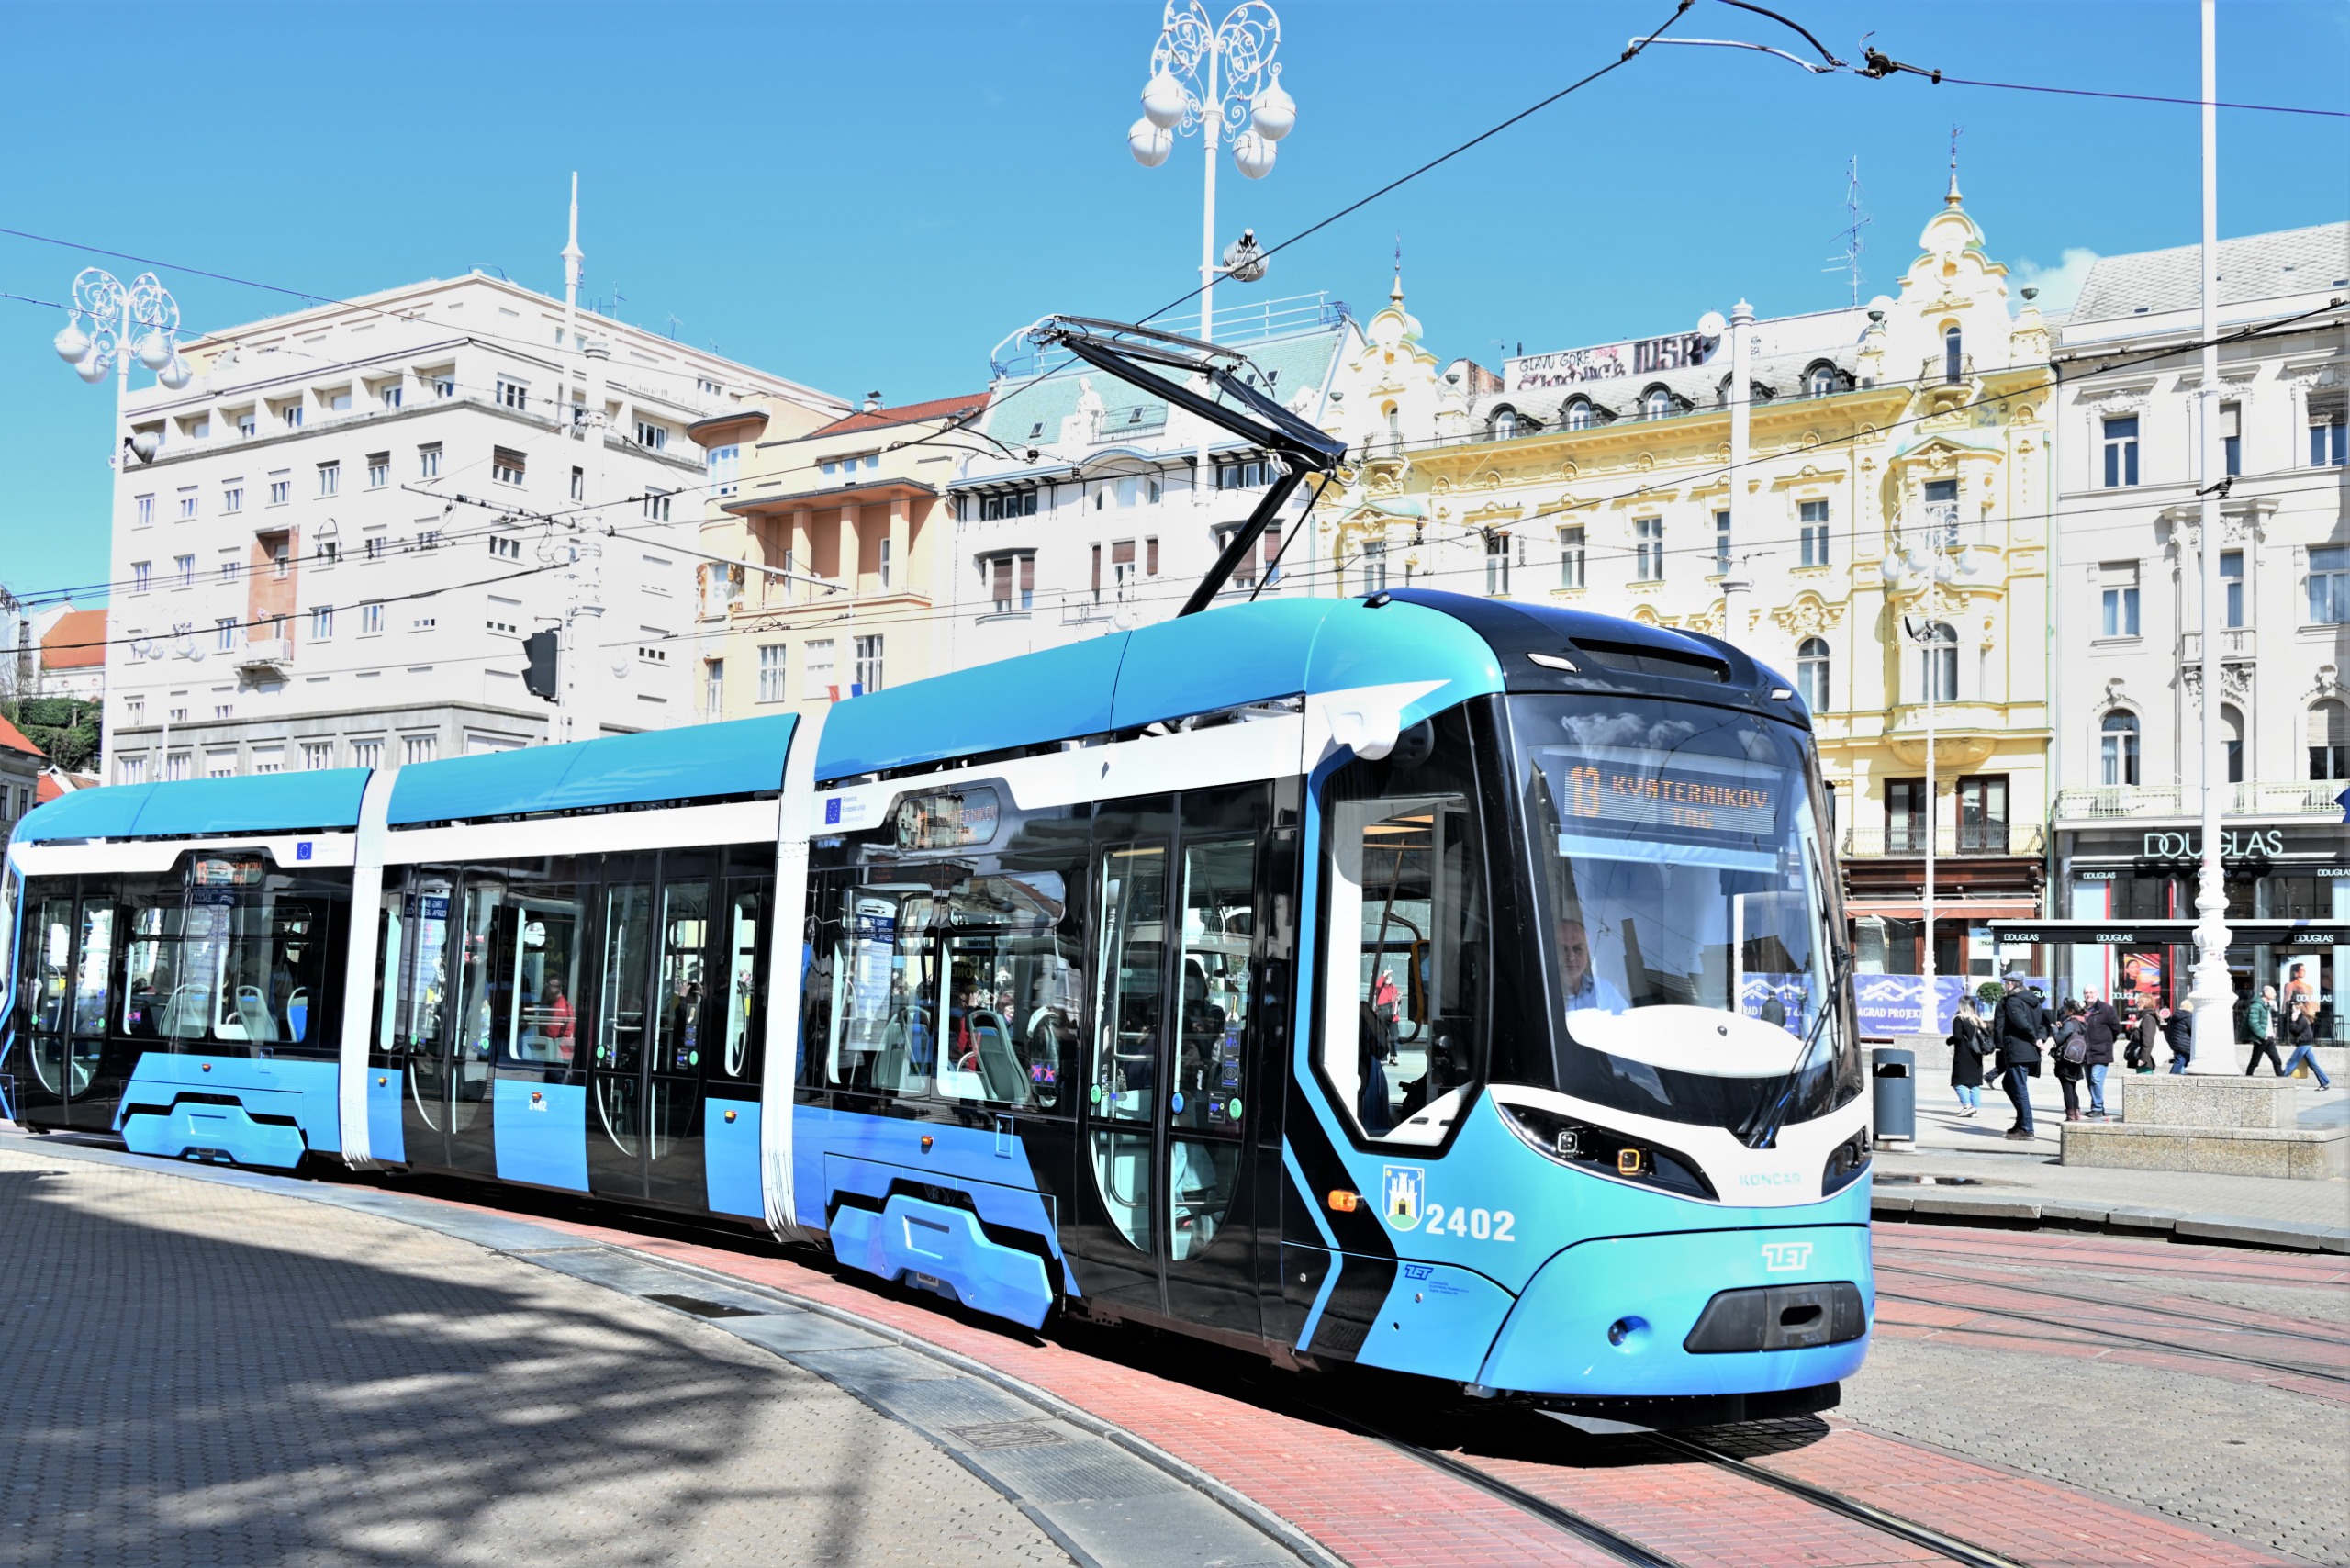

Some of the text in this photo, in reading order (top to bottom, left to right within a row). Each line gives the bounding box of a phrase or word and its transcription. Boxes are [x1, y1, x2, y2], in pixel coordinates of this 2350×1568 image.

[1571, 765, 1768, 818] 13 KVATERNIKOV
[1673, 806, 1714, 830] TRG
[2083, 871, 2116, 879] DOUGLAS
[2318, 868, 2350, 877] DOUGLA
[2096, 934, 2132, 942] DOUGLAS
[2294, 934, 2334, 943] DOUGLAS
[1426, 1204, 1515, 1241] 2402
[1762, 1242, 1813, 1272] ZET
[1404, 1264, 1434, 1281] ZET
